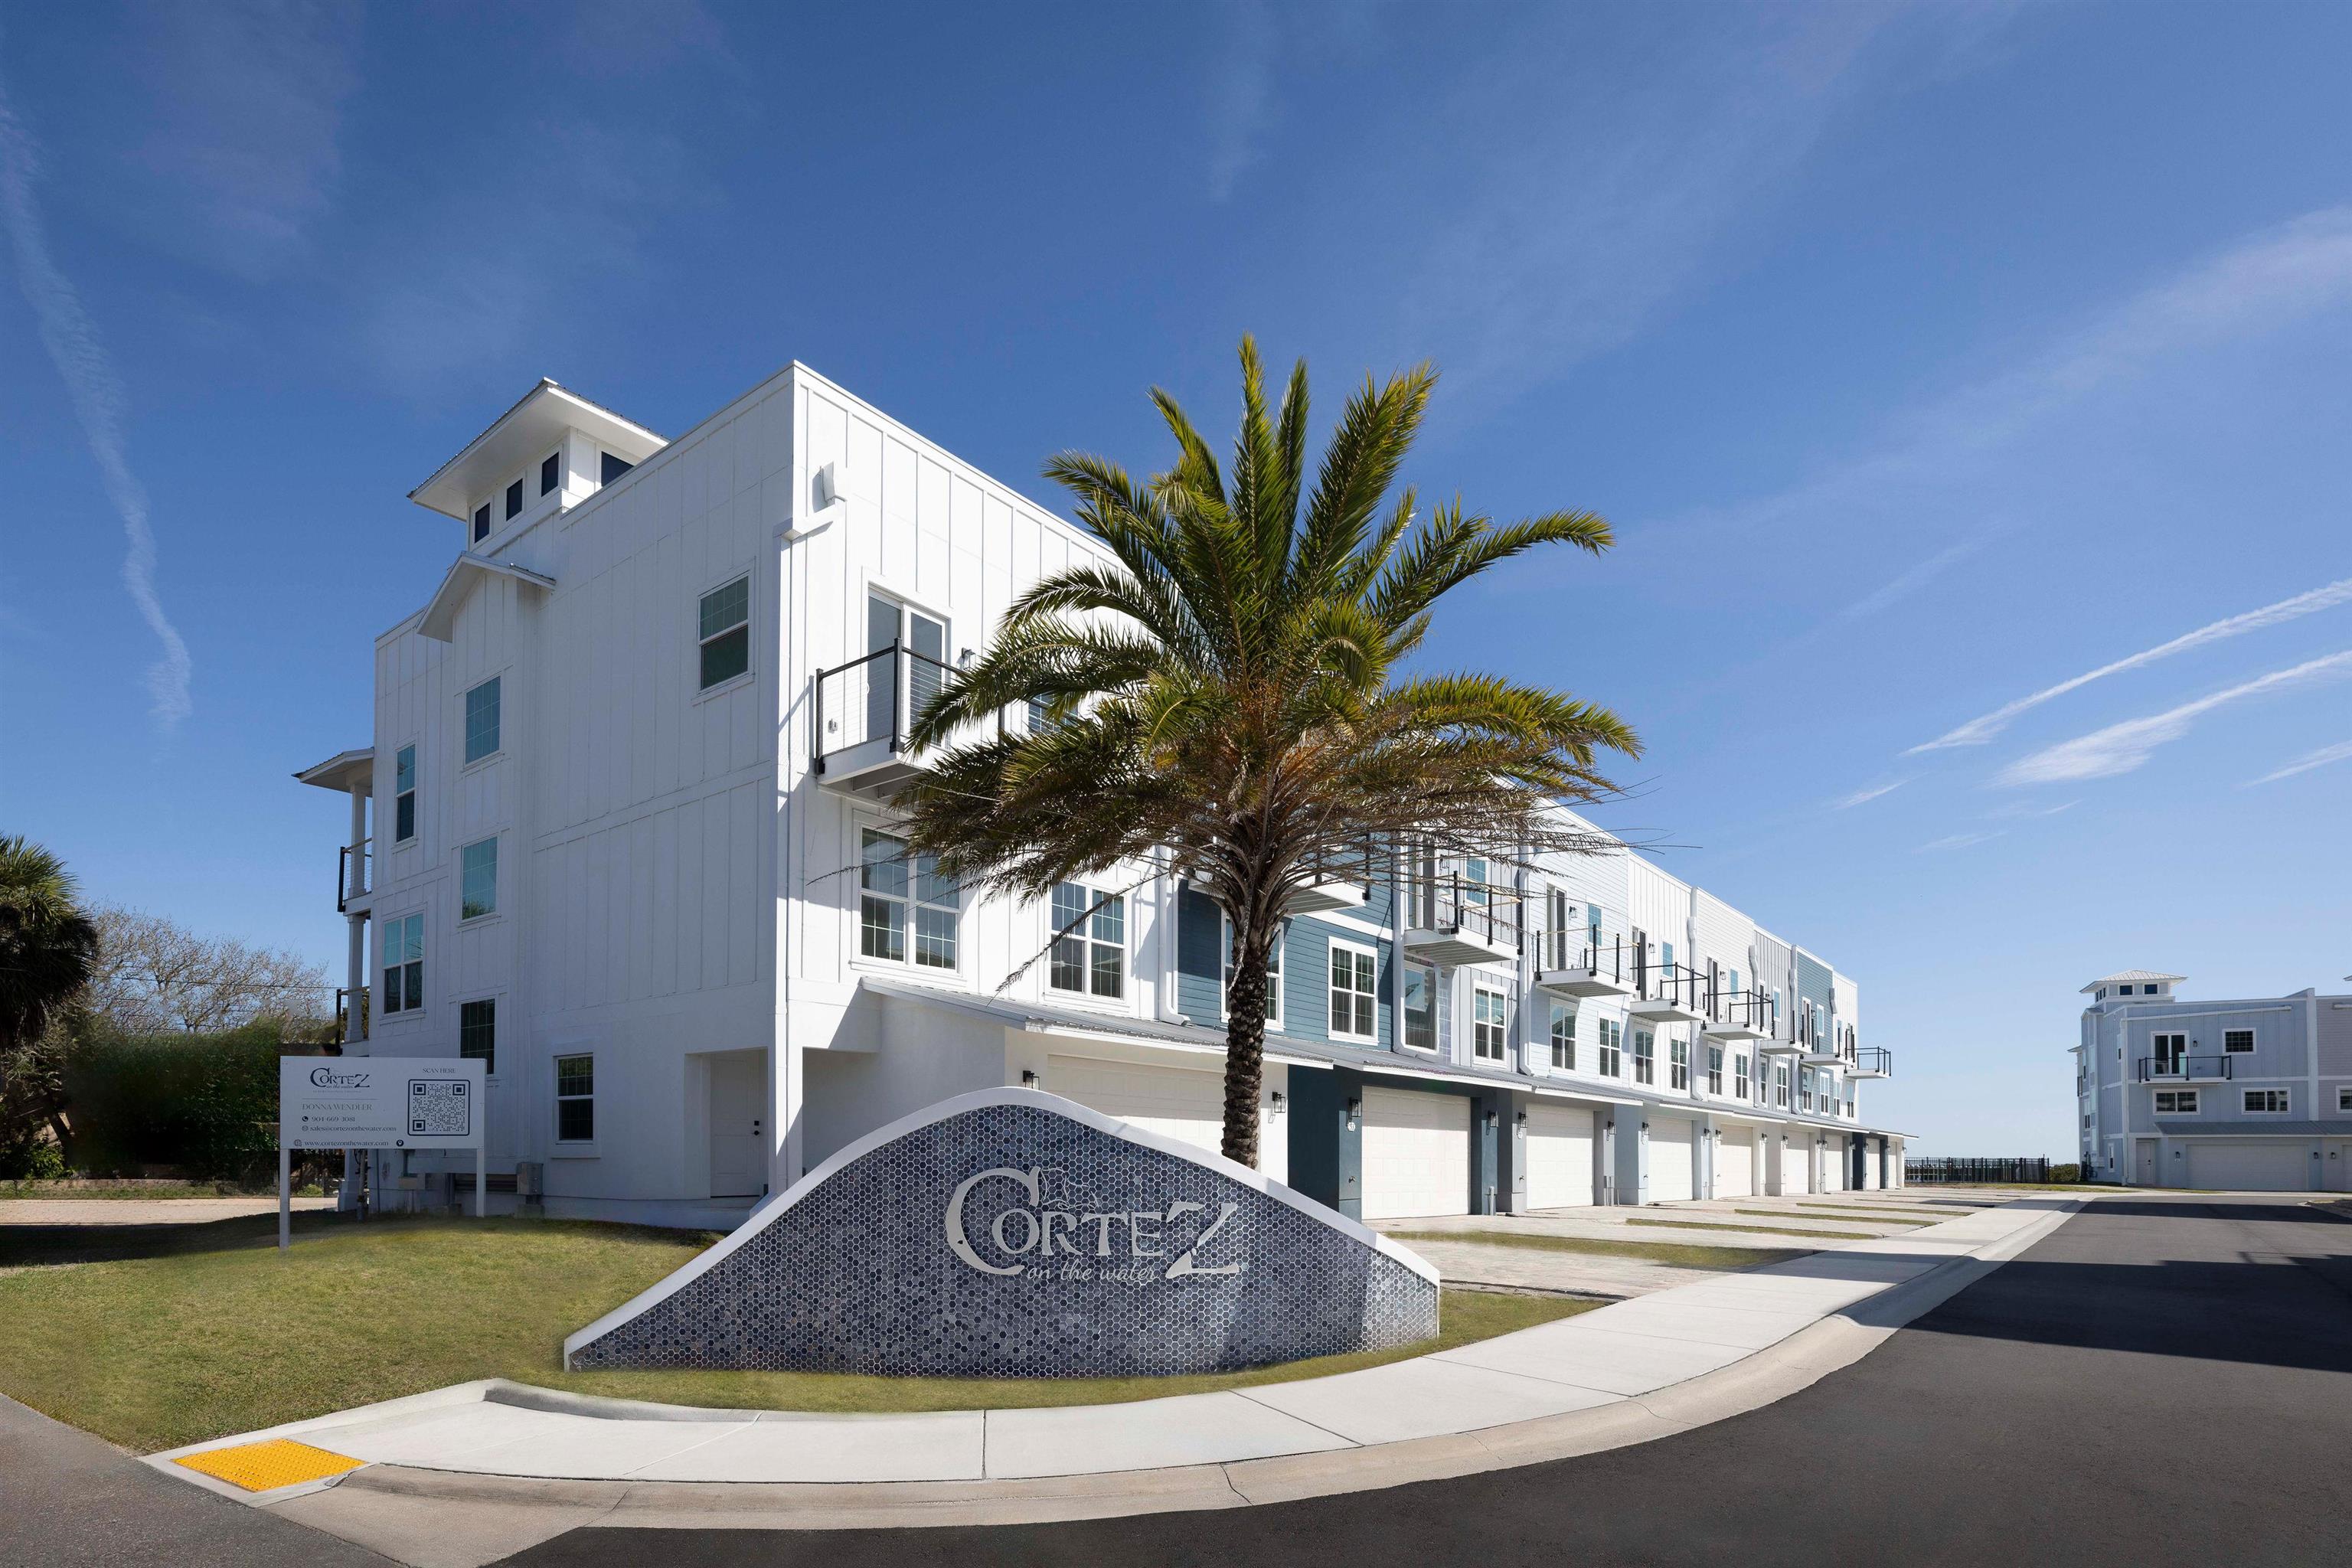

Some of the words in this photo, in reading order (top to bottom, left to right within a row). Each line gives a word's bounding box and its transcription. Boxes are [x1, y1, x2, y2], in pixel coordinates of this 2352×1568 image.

[310, 1067, 370, 1088] CORTEZ
[945, 1166, 1240, 1279] CORTEZ
[1027, 1266, 1050, 1280] on
[1058, 1259, 1092, 1282] the
[1099, 1261, 1157, 1282] water
